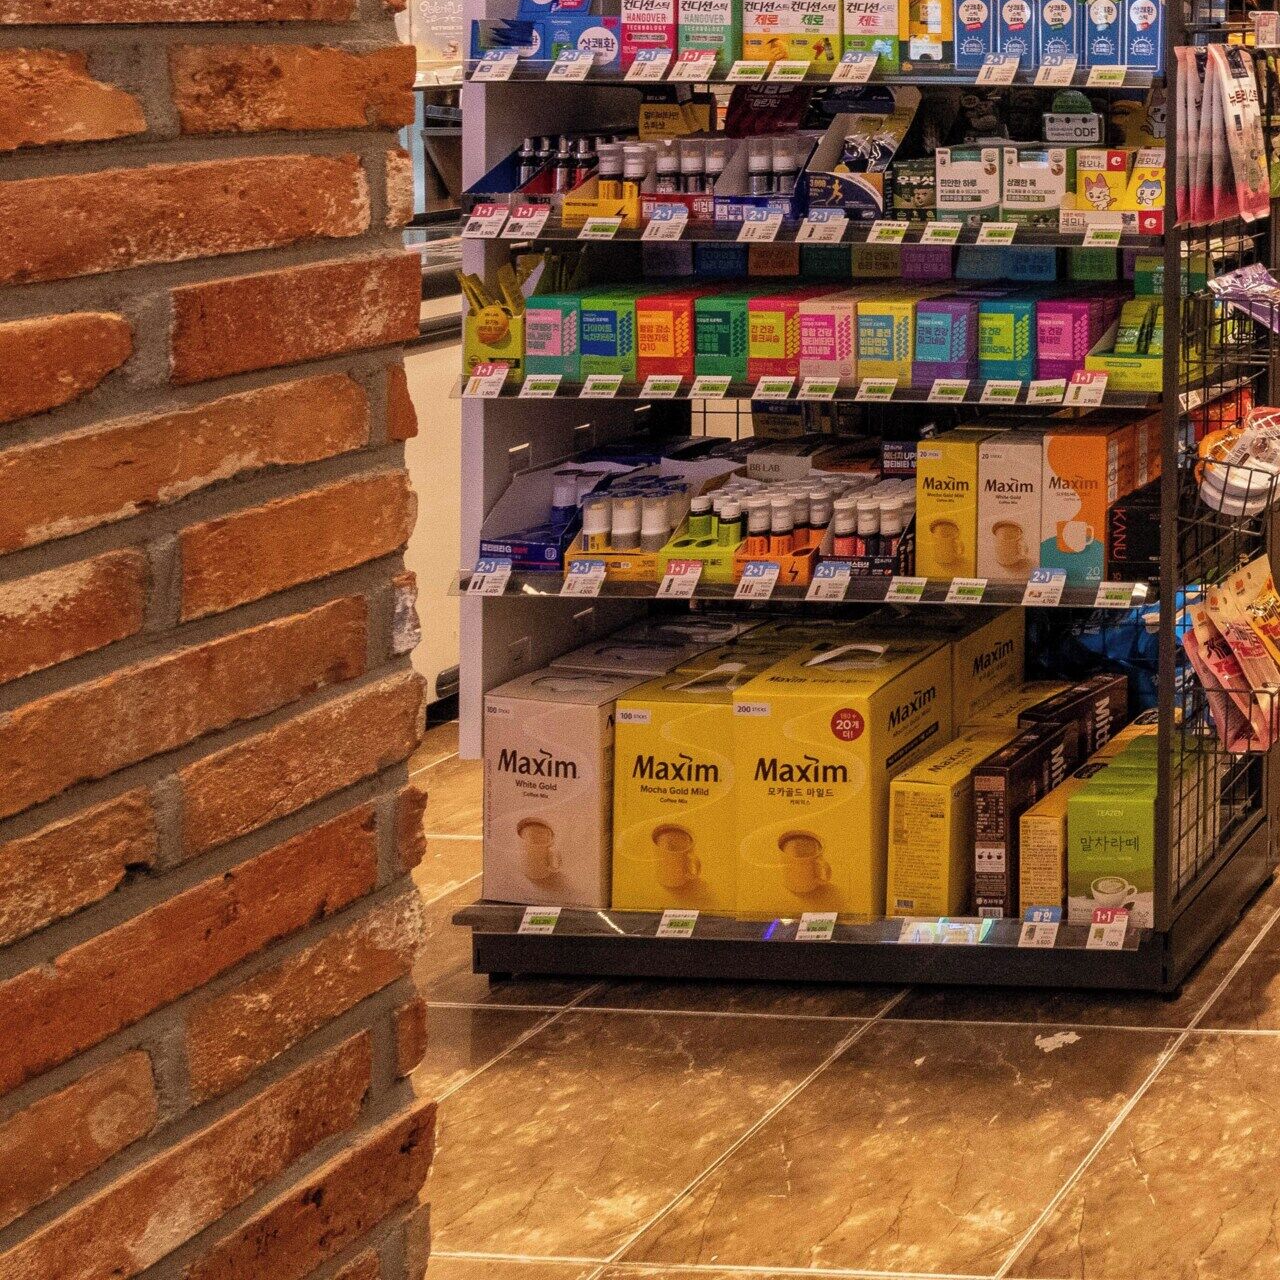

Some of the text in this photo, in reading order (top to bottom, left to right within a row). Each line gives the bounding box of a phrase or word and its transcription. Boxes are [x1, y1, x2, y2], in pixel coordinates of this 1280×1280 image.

[626, 13, 667, 23] HANGOVER
[684, 13, 725, 23] HANGOVER
[755, 15, 780, 25] 제로
[801, 15, 825, 25] 제로
[579, 37, 616, 52] 상쾌환
[484, 51, 504, 61] 2+1
[559, 51, 580, 61] 2+1
[637, 51, 657, 61] 2+1
[682, 51, 700, 61] 1+1
[844, 53, 863, 63] 2+1
[986, 54, 1005, 65] 2+1
[1043, 54, 1063, 65] 2+1
[1073, 127, 1097, 139] ODF
[476, 206, 493, 217] 1+1
[517, 206, 534, 218] 1+1
[653, 209, 673, 220] 2+1
[749, 209, 768, 220] 2+1
[811, 210, 829, 222] 2+1
[475, 365, 493, 376] 1+1
[1075, 373, 1093, 383] 1+1
[922, 476, 971, 491] Maxim
[984, 477, 1034, 493] Maxim
[1048, 475, 1099, 490] Maxim
[1112, 509, 1127, 561] KANU
[476, 562, 495, 572] 2+1
[571, 562, 590, 573] 2+1
[668, 564, 686, 575] 1+1
[744, 564, 764, 575] 2+1
[817, 566, 835, 577] 2+1
[1031, 571, 1050, 582] 2+1
[972, 638, 1014, 674] Maxim
[737, 705, 751, 713] 200
[887, 684, 937, 731] Maxim
[620, 712, 633, 720] 100
[835, 719, 860, 731] 20개
[498, 748, 580, 780] Maxim
[632, 753, 721, 783] Maxim
[754, 754, 848, 783] Maxim
[515, 779, 557, 791] White Gold
[641, 784, 709, 796] Mocha Gold Mild
[767, 787, 834, 798] 모카골드 마일드
[1079, 835, 1140, 851] 말차라떼
[1097, 909, 1115, 922] 1+1
